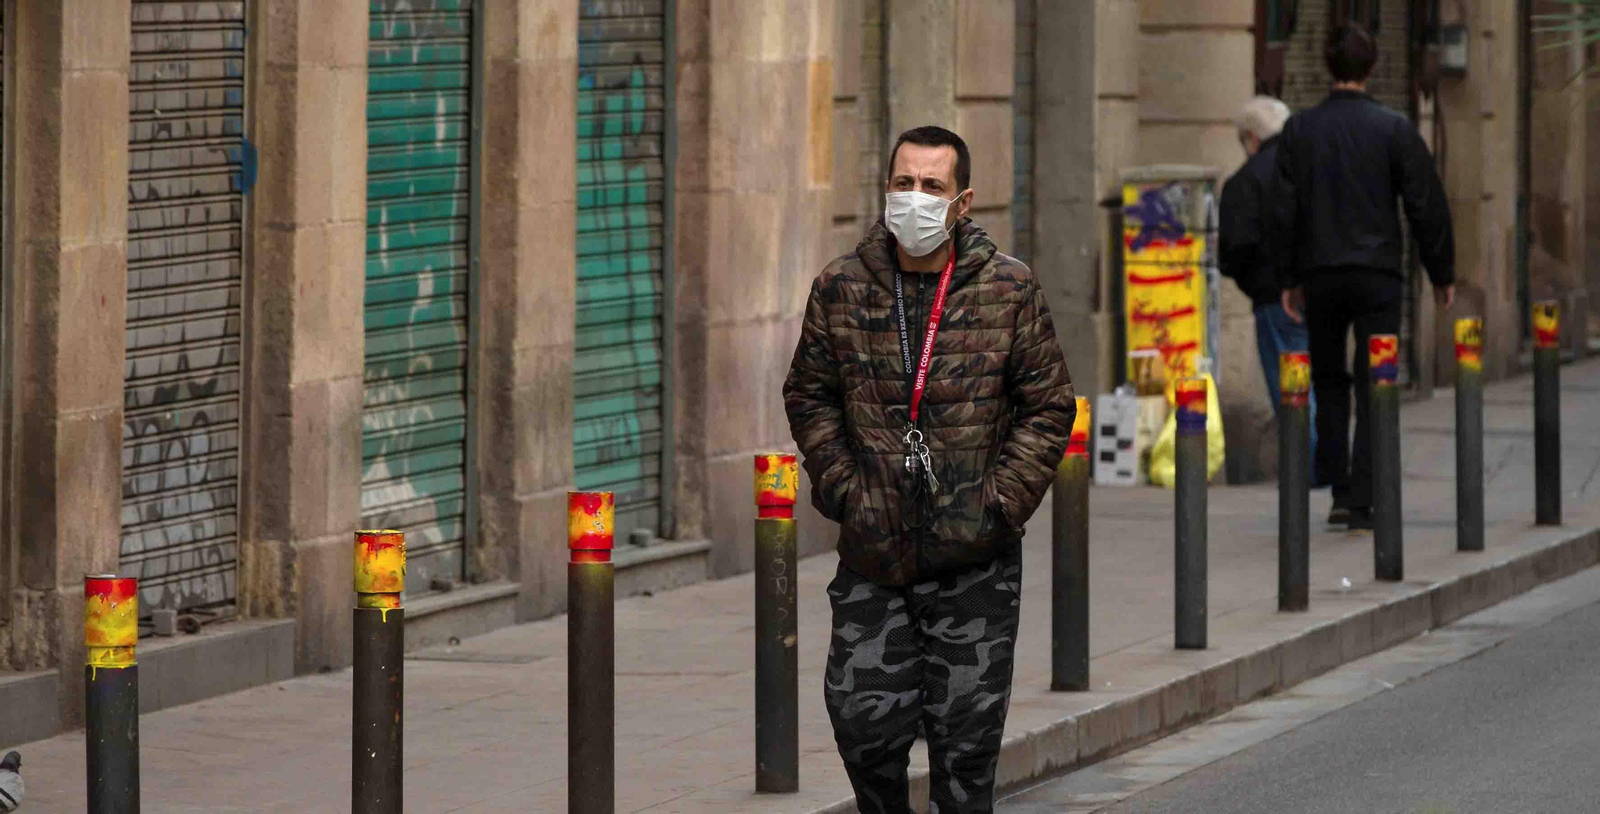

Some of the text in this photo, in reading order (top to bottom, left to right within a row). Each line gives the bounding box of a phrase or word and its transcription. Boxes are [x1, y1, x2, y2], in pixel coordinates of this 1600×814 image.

[898, 298, 906, 330] REALISMO
[901, 331, 907, 339] ES
[903, 339, 912, 373] COLOMBIA
[915, 329, 935, 390] VISITE COLOMBIA
